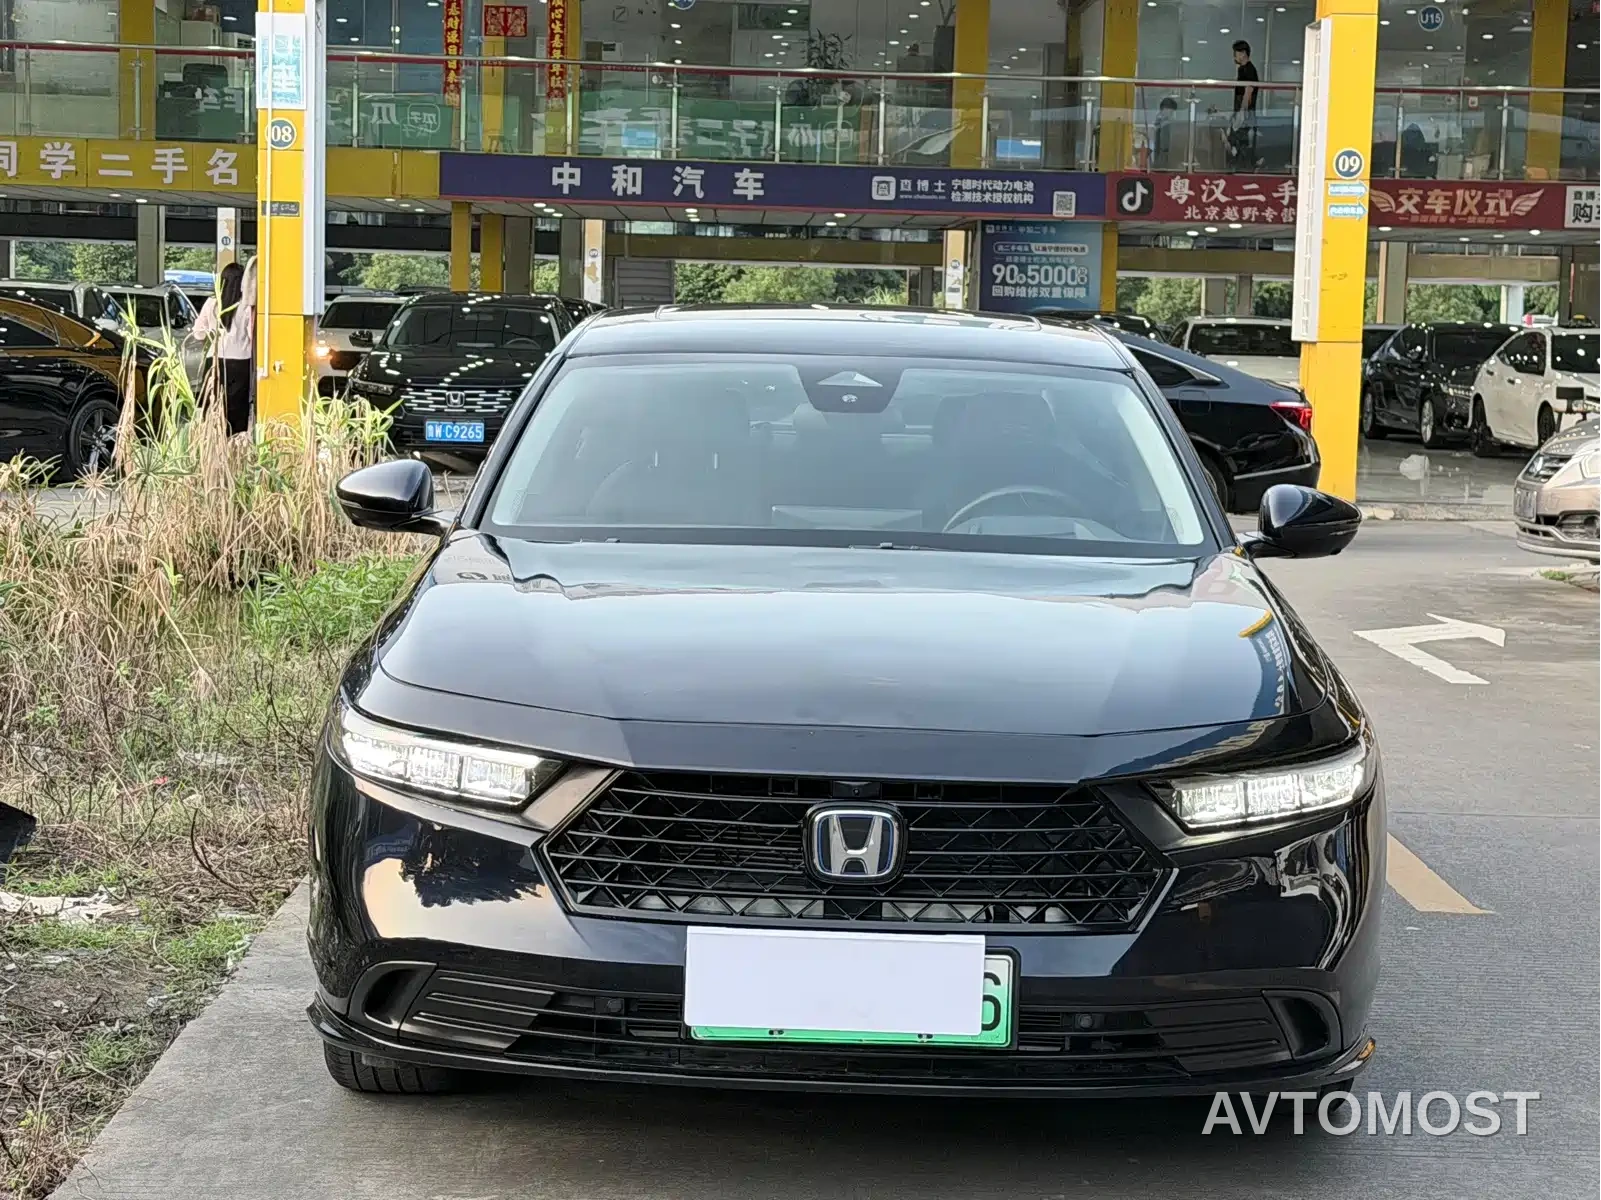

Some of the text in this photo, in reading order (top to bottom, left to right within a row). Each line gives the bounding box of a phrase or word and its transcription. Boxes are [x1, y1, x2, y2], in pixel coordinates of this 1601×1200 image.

[1420, 12, 1441, 23] U15
[271, 125, 292, 142] 08
[1339, 155, 1360, 172] 09
[552, 161, 765, 201] 中和汽车
[951, 178, 1034, 191] 宁德时代动力电池
[951, 191, 1034, 204] 检测技术授权机构
[1164, 175, 1298, 206] 粤汉二手
[1396, 188, 1513, 217] 交车仪式
[1184, 205, 1297, 223] 北京越野专营
